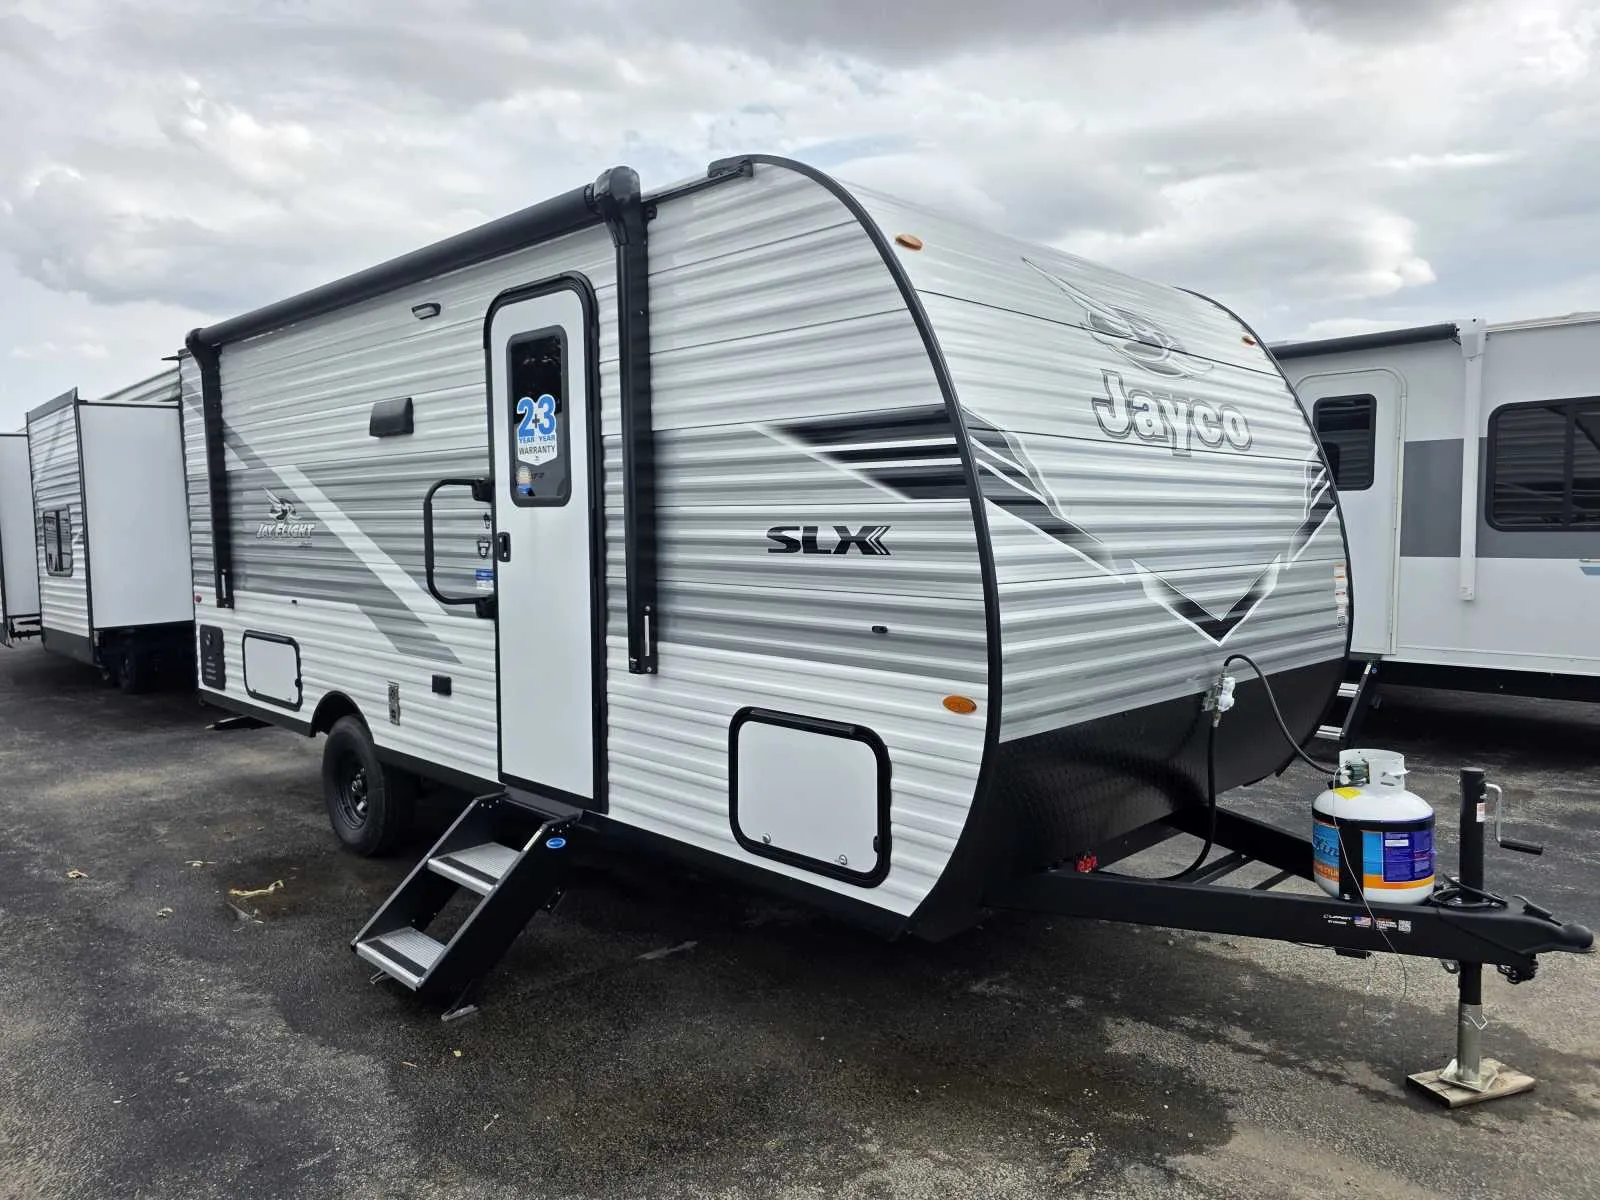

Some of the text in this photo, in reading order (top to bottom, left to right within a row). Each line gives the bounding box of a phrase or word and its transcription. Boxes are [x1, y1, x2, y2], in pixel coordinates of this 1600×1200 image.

[1091, 368, 1253, 456] Jayco
[538, 434, 556, 442] YEAR
[518, 445, 556, 455] WARRANTY
[766, 525, 891, 555] SLX
